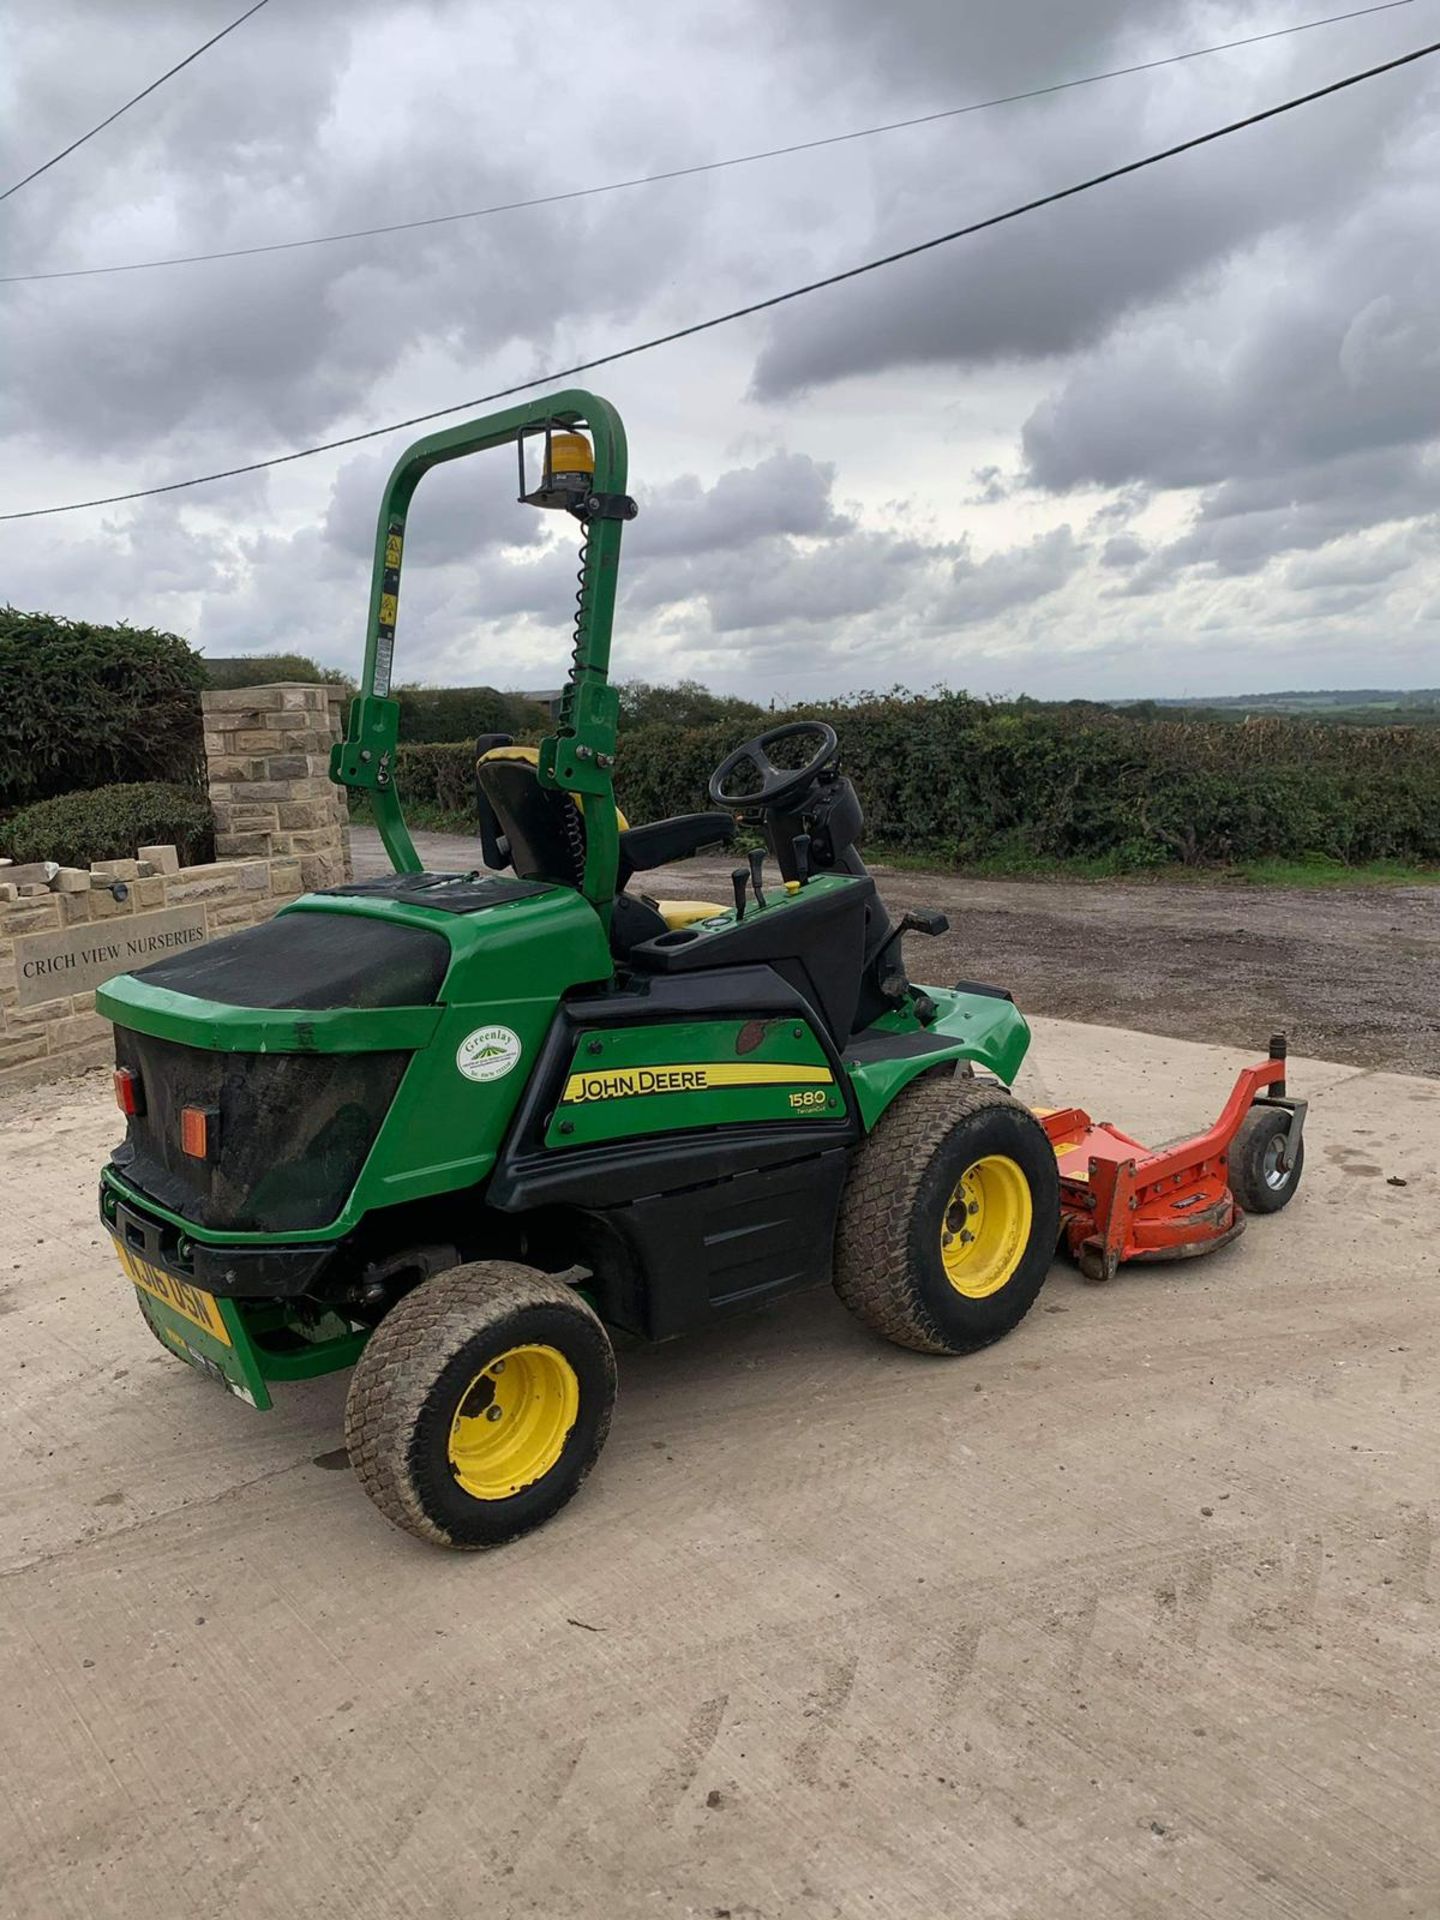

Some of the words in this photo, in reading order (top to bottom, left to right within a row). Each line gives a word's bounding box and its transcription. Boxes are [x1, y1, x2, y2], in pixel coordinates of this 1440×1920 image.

[23, 953, 76, 978] CRICH
[81, 943, 122, 964] VIEW
[125, 927, 204, 956] NURSERIES
[575, 1076, 634, 1100] JOHN
[638, 1071, 707, 1092] DEERE
[789, 1090, 826, 1107] 1580
